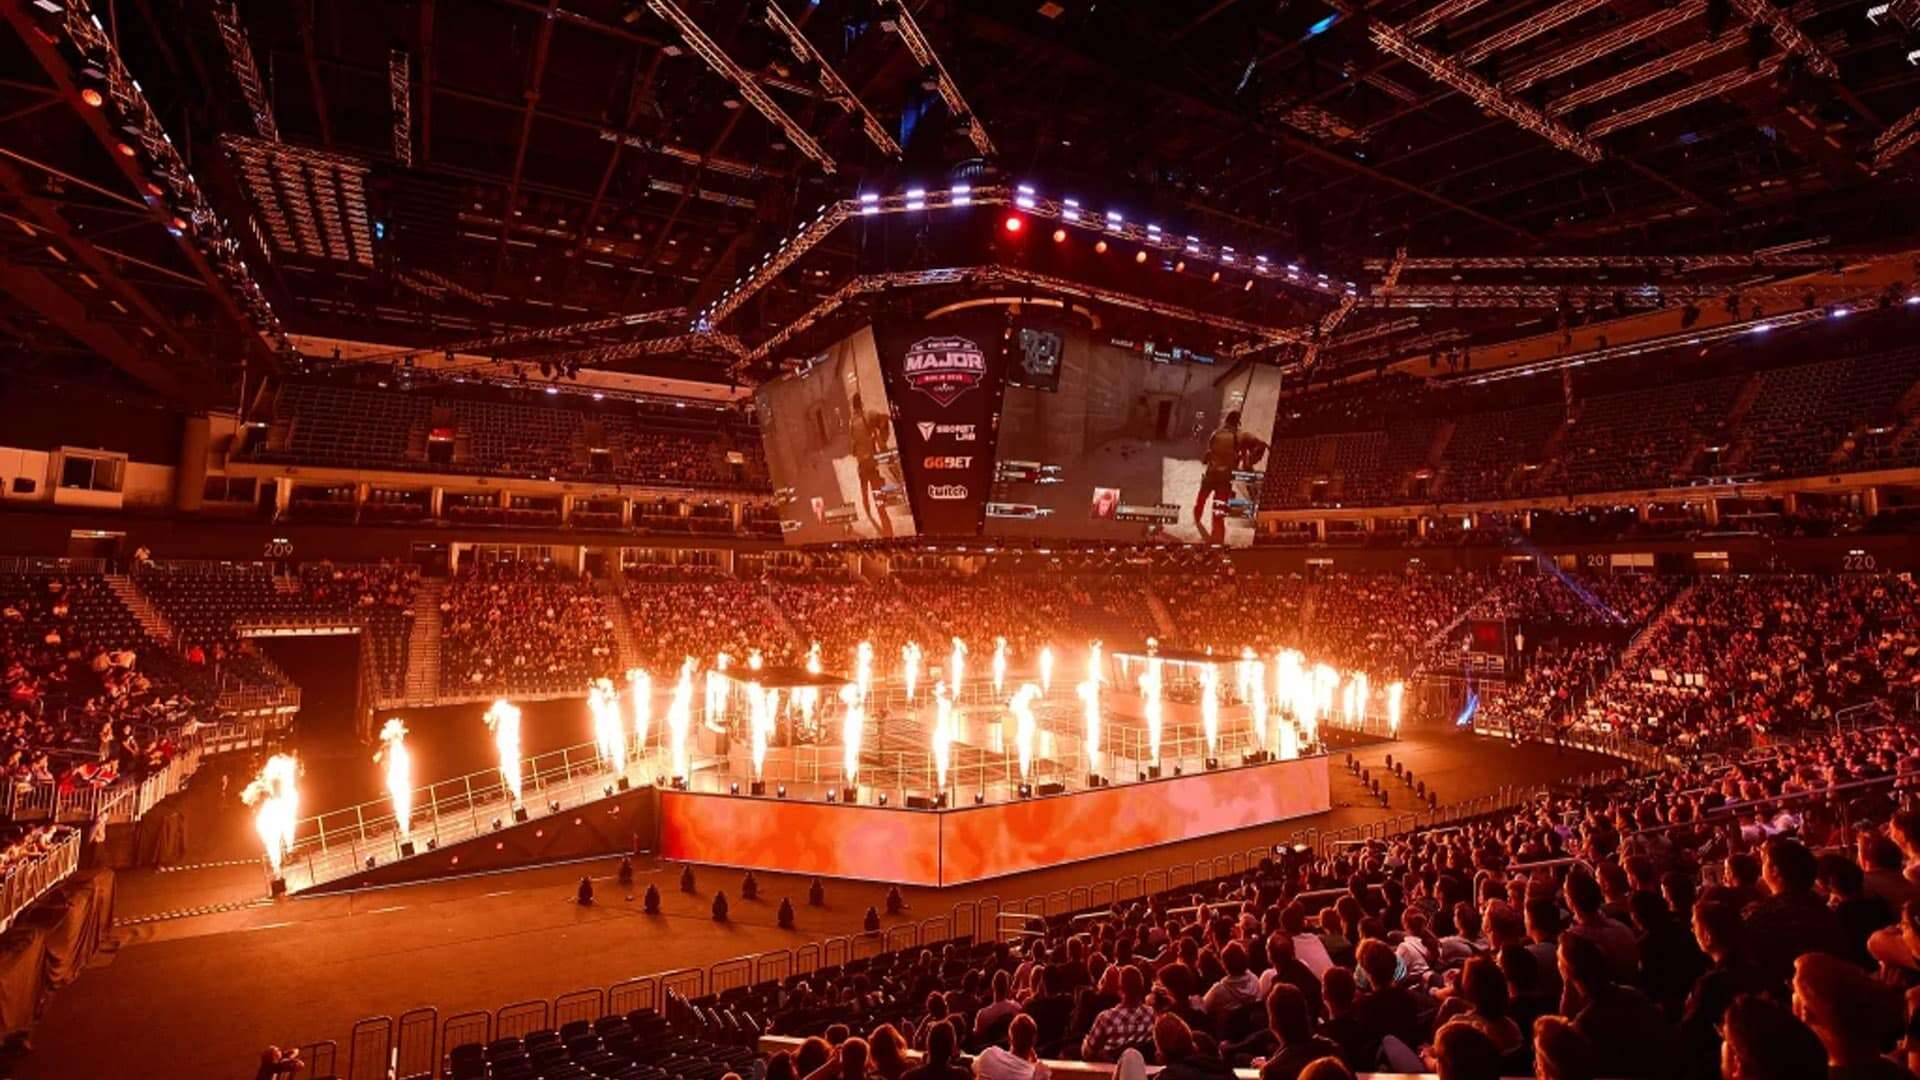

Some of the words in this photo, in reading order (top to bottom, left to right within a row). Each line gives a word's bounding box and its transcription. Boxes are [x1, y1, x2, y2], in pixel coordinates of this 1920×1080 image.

[905, 353, 983, 372] MAJOR
[928, 484, 968, 499] twitch
[264, 543, 294, 557] 209
[1843, 555, 1876, 570] 220
